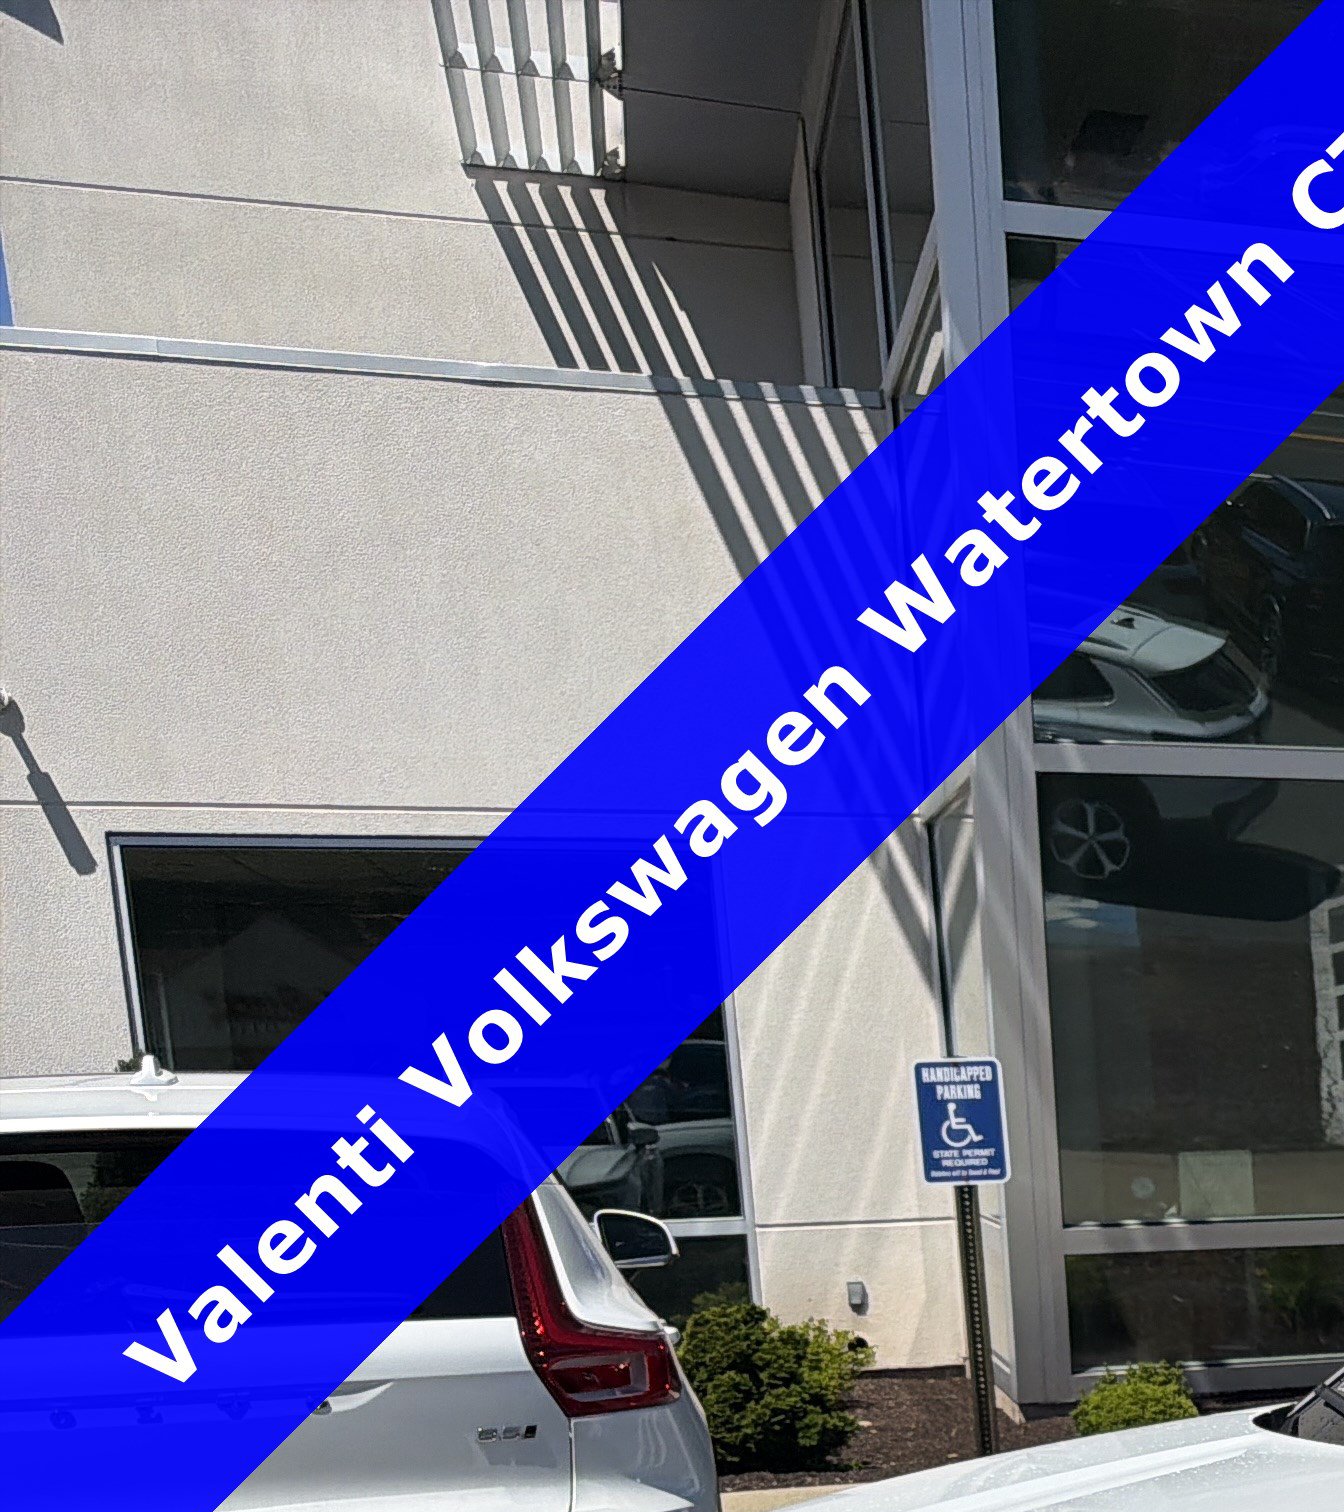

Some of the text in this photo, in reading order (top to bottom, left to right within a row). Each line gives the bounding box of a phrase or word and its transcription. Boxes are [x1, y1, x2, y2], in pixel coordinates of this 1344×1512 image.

[921, 1065, 993, 1083] HANDICAPPED
[936, 1083, 982, 1100] PARKING
[962, 1147, 996, 1158] PERMIT
